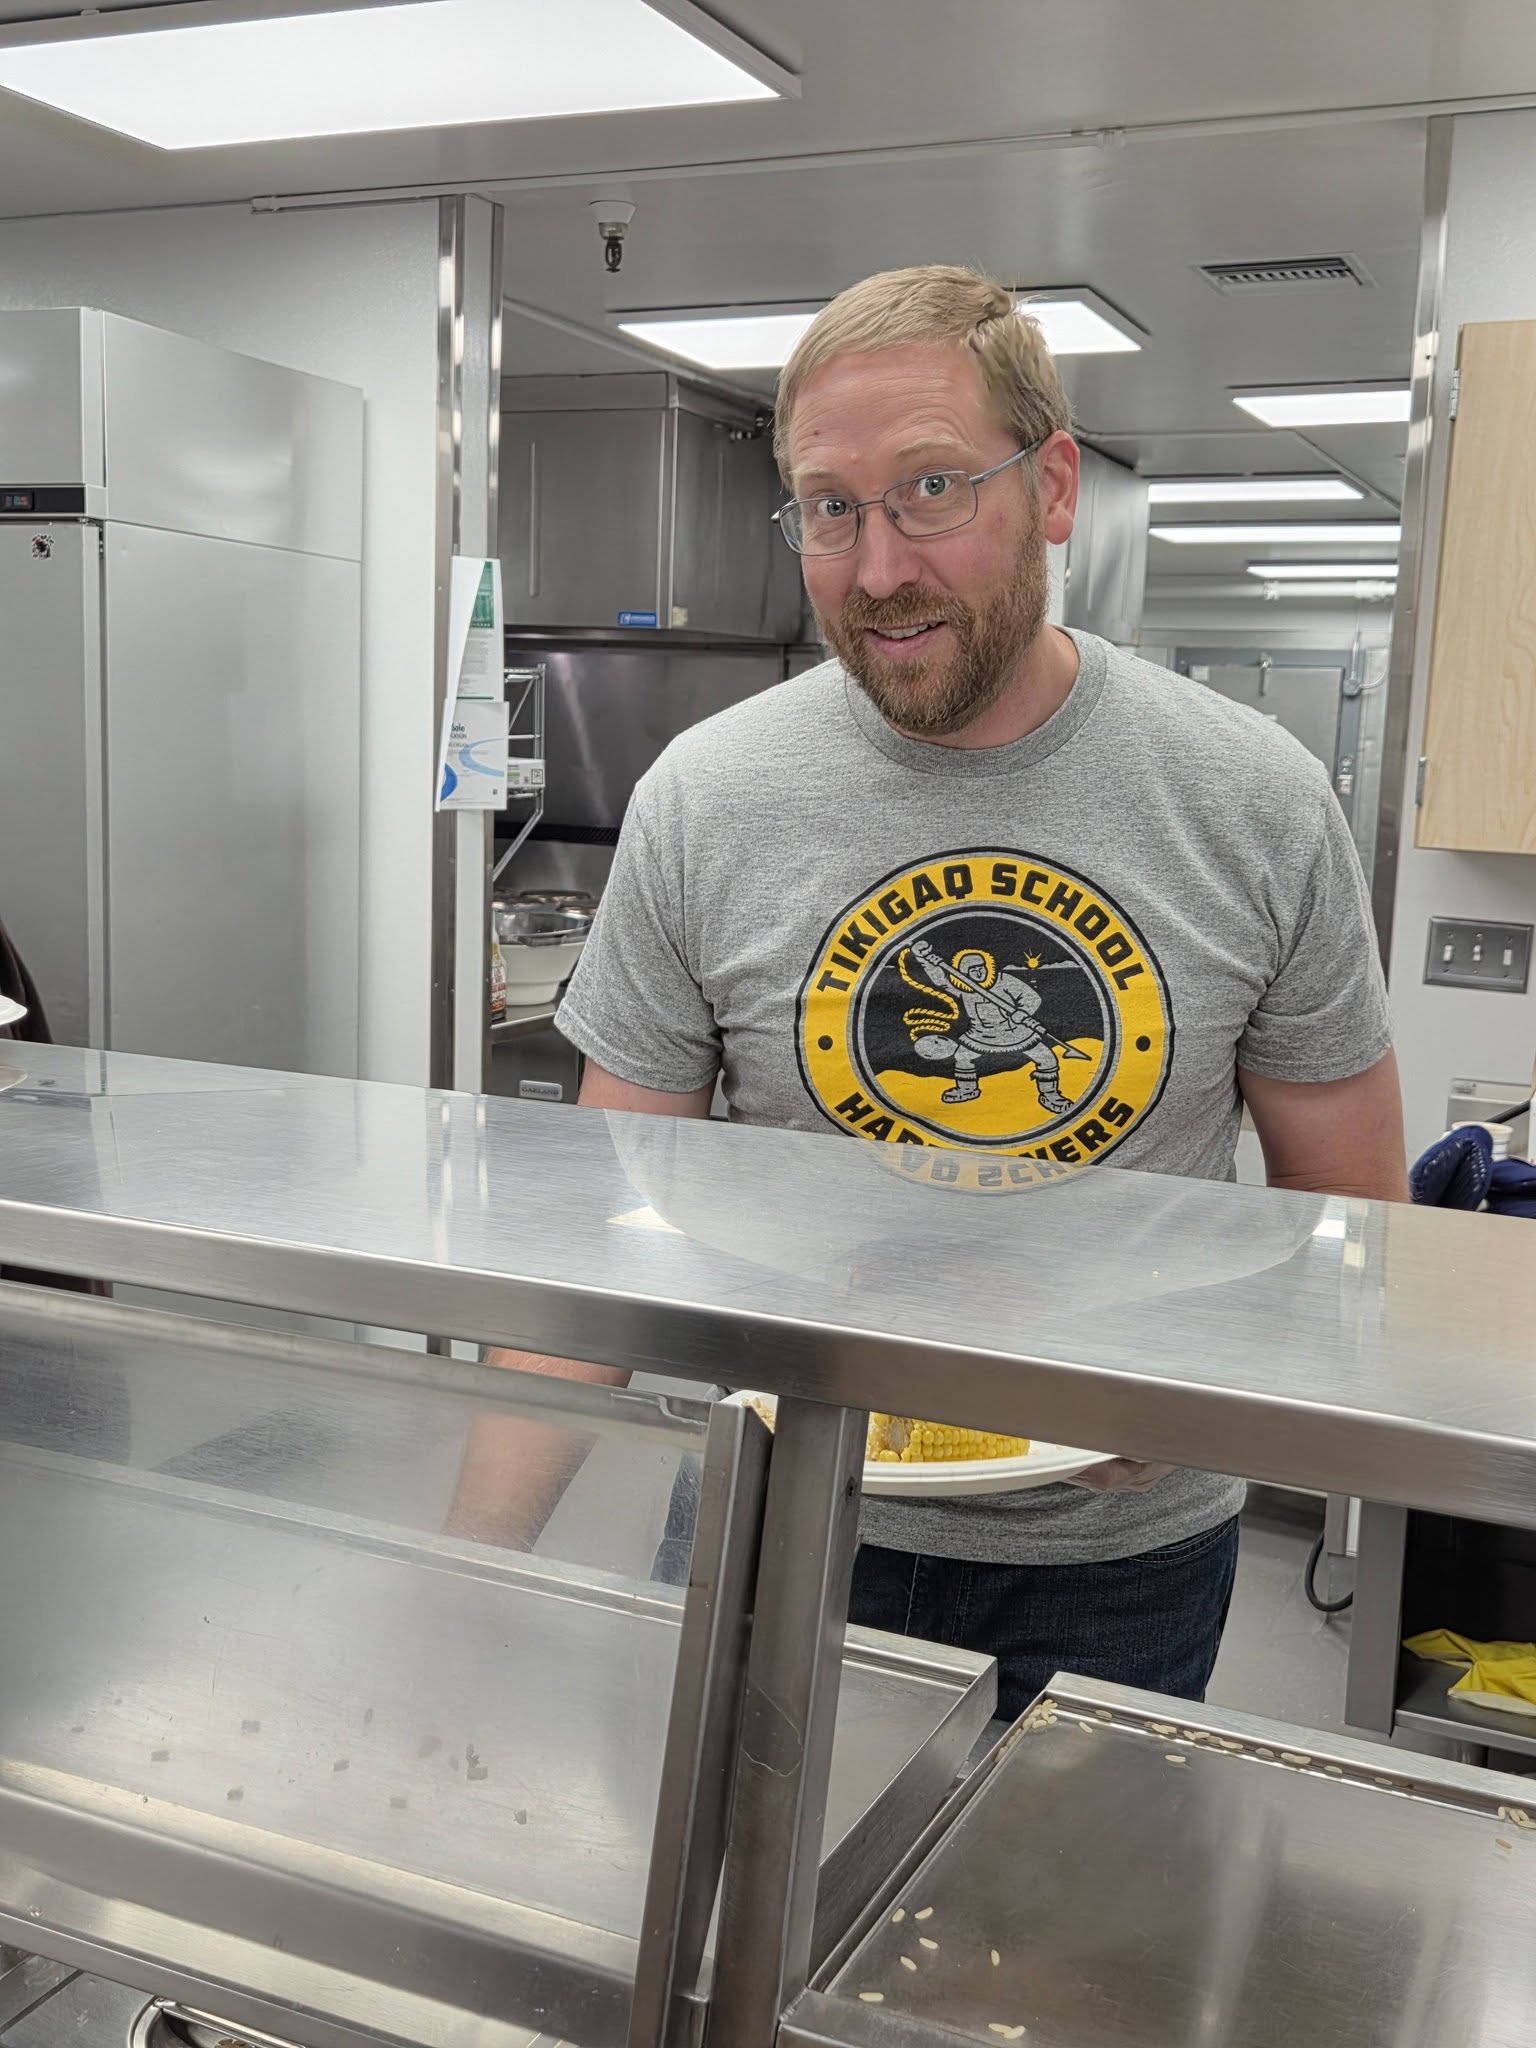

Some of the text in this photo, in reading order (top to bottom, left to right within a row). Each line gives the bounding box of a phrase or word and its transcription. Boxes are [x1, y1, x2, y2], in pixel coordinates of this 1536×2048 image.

[817, 863, 1144, 993] TIKIGAQ SCHOOL
[834, 1096, 1134, 1164] HAERS
